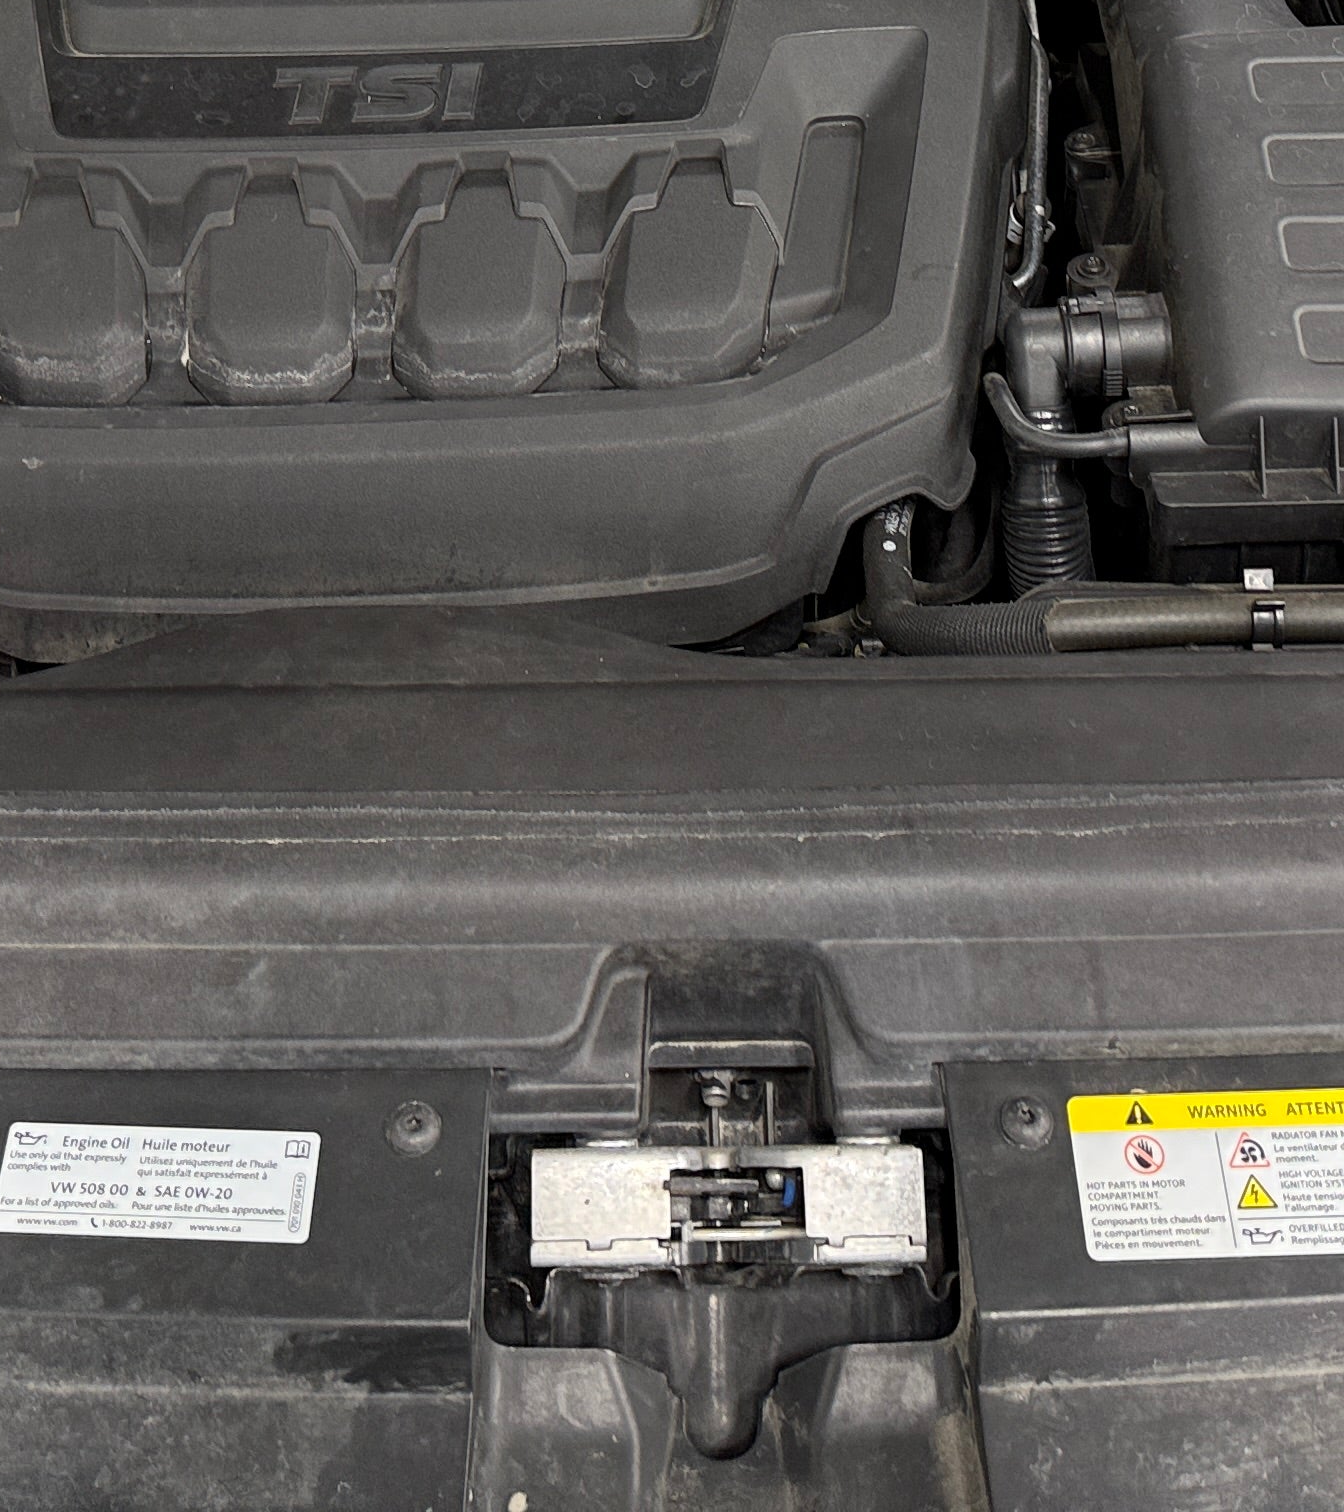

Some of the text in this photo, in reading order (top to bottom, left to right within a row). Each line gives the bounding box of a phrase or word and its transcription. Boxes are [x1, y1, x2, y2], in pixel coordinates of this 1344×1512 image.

[274, 62, 484, 126] TSI
[1187, 1103, 1267, 1119] WARNING
[1271, 1130, 1318, 1140] RADIATOR
[1319, 1130, 1339, 1138] FAN
[62, 1136, 131, 1151] Engine Oil
[142, 1139, 231, 1153] Huile moteur
[1273, 1144, 1285, 1153] Le
[1287, 1142, 1338, 1152] ventilateur
[9, 1150, 127, 1165] Use only oil that expressly
[139, 1156, 278, 1170] Utilisez uniquement de l'huile
[1275, 1154, 1319, 1164] moment.
[7, 1162, 72, 1173] complies with
[136, 1169, 268, 1182] qui satisfait expressément à
[1278, 1170, 1302, 1180] HIGH
[1086, 1178, 1186, 1190] HOT PARTS IN MOTOR
[1281, 1179, 1323, 1189] IGNITION
[50, 1181, 233, 1201] VW 508 00 & SAE 0W-20
[1283, 1192, 1312, 1202] Haute
[0, 1196, 16, 1206] For
[17, 1198, 23, 1206] a
[25, 1196, 40, 1206] list
[41, 1196, 52, 1207] of
[53, 1199, 98, 1210] approved
[131, 1200, 154, 1211] Pour
[154, 1202, 172, 1212] une
[173, 1202, 194, 1212] liste
[194, 1203, 231, 1213] d'huiles
[1090, 1201, 1162, 1212] MOVING PARTS.
[1285, 1202, 1337, 1213] l'allumage.
[16, 1217, 78, 1227] www.vw.com
[101, 1218, 173, 1230] 1-800-822-8987
[1091, 1213, 1227, 1227] Composants très chauds dans
[189, 1223, 242, 1233] www.vw.ca
[1094, 1228, 1102, 1238] le
[1104, 1227, 1175, 1239] compartiment
[1094, 1238, 1203, 1250] Pièces en mouvement.
